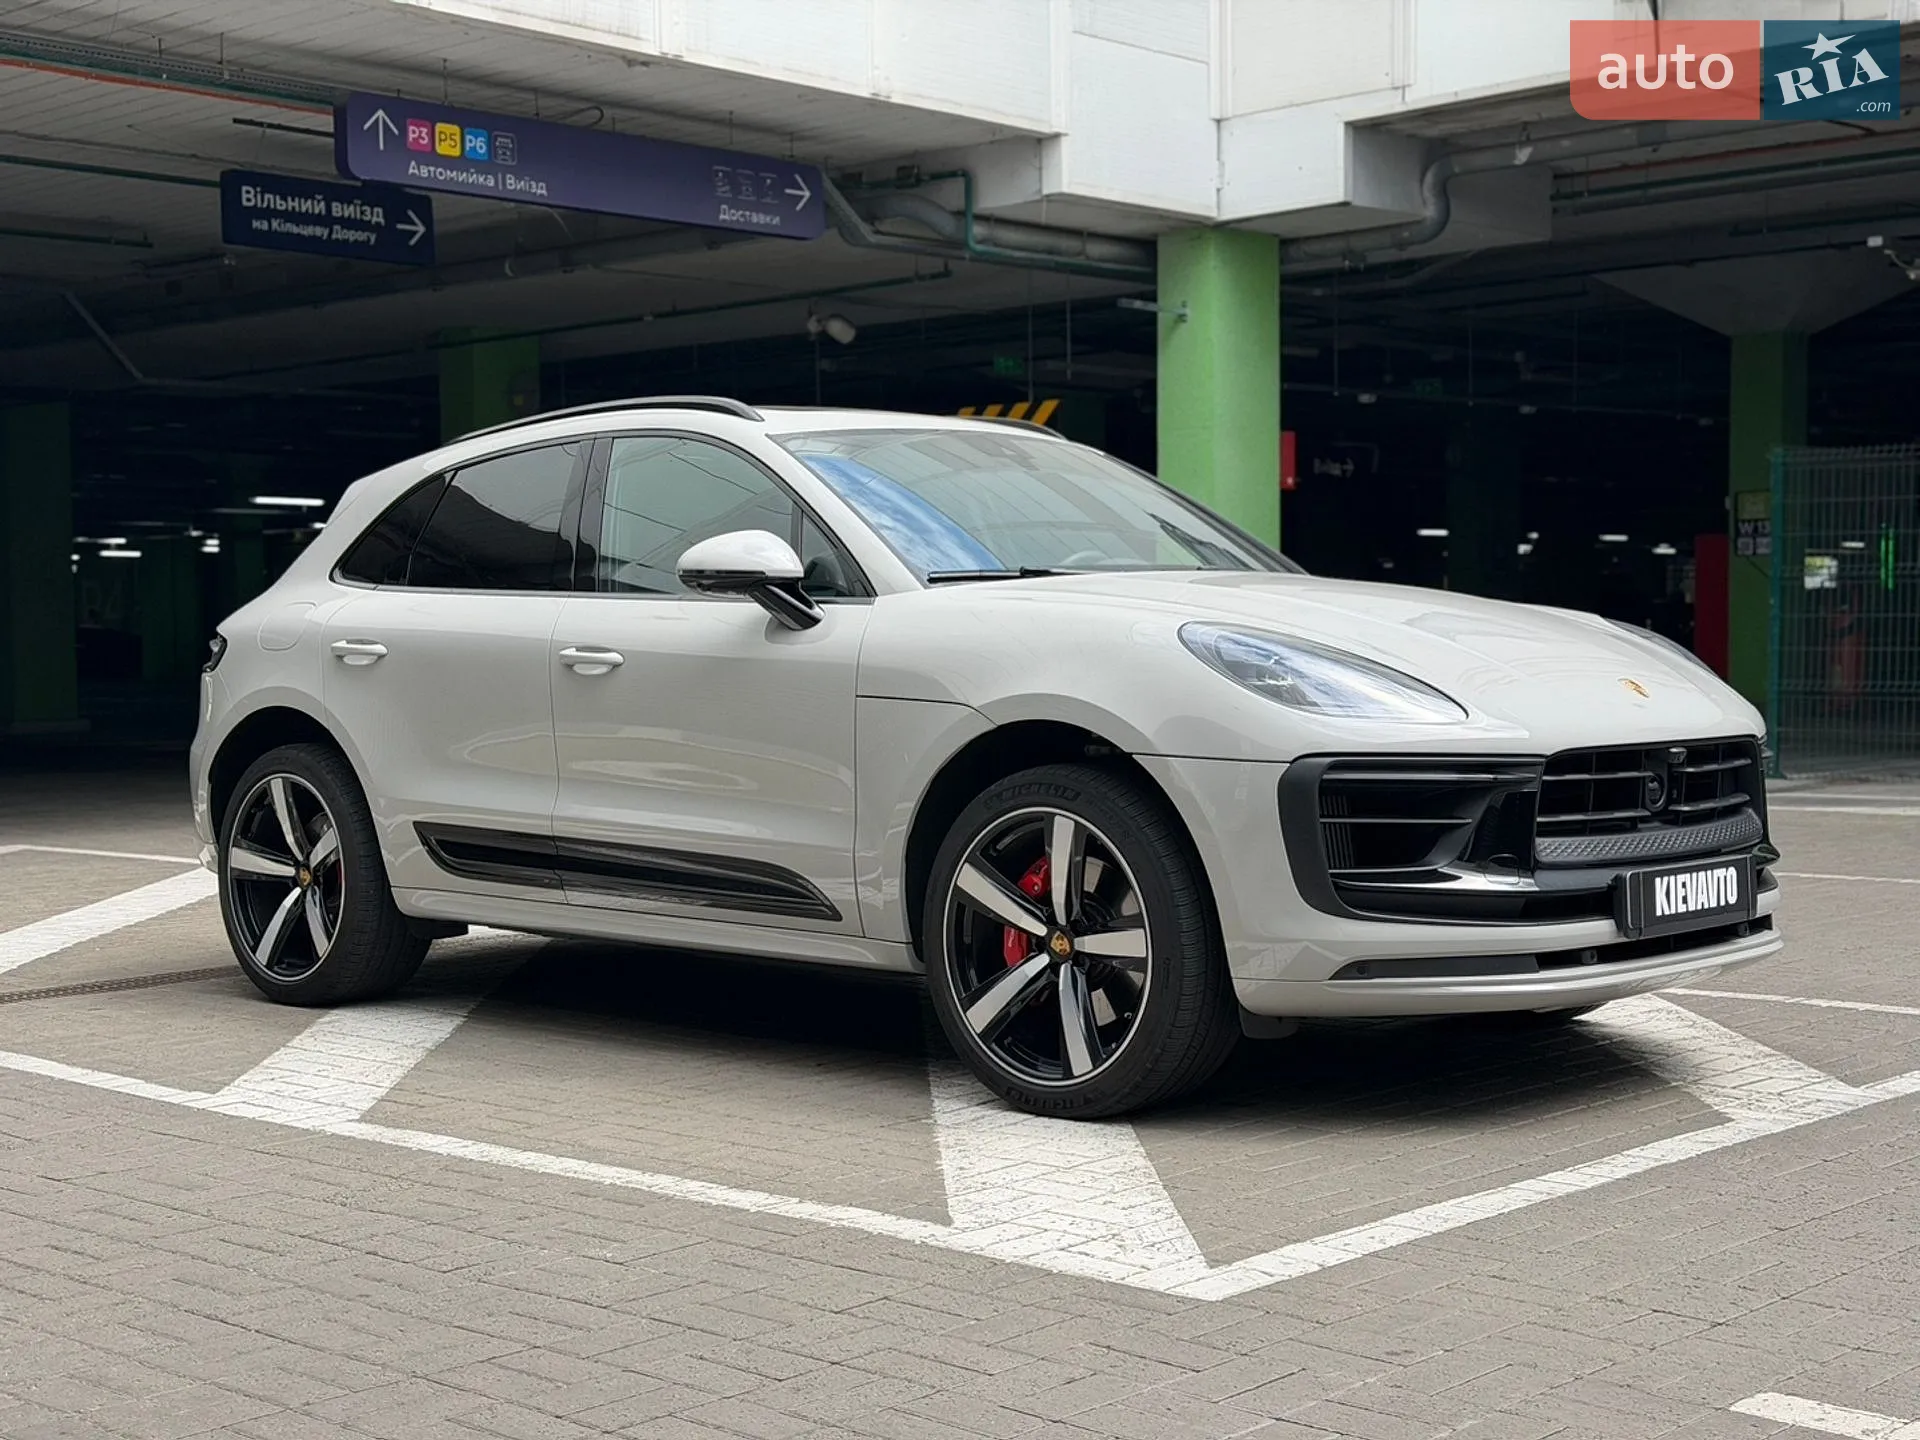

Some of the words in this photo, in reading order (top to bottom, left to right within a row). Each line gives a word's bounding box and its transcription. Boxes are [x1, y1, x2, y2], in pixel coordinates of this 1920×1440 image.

[407, 126, 430, 145] P3
[438, 130, 458, 150] P5
[465, 134, 488, 154] P6
[407, 160, 495, 187] Автомийка
[505, 174, 548, 197] Виїзд
[240, 184, 327, 216] Вільний
[331, 200, 386, 226] виїзд
[718, 204, 782, 226] Доставки
[271, 218, 329, 240] Кільцеву
[331, 225, 378, 246] Дорогу
[1654, 866, 1738, 916] KIEVAVTO
